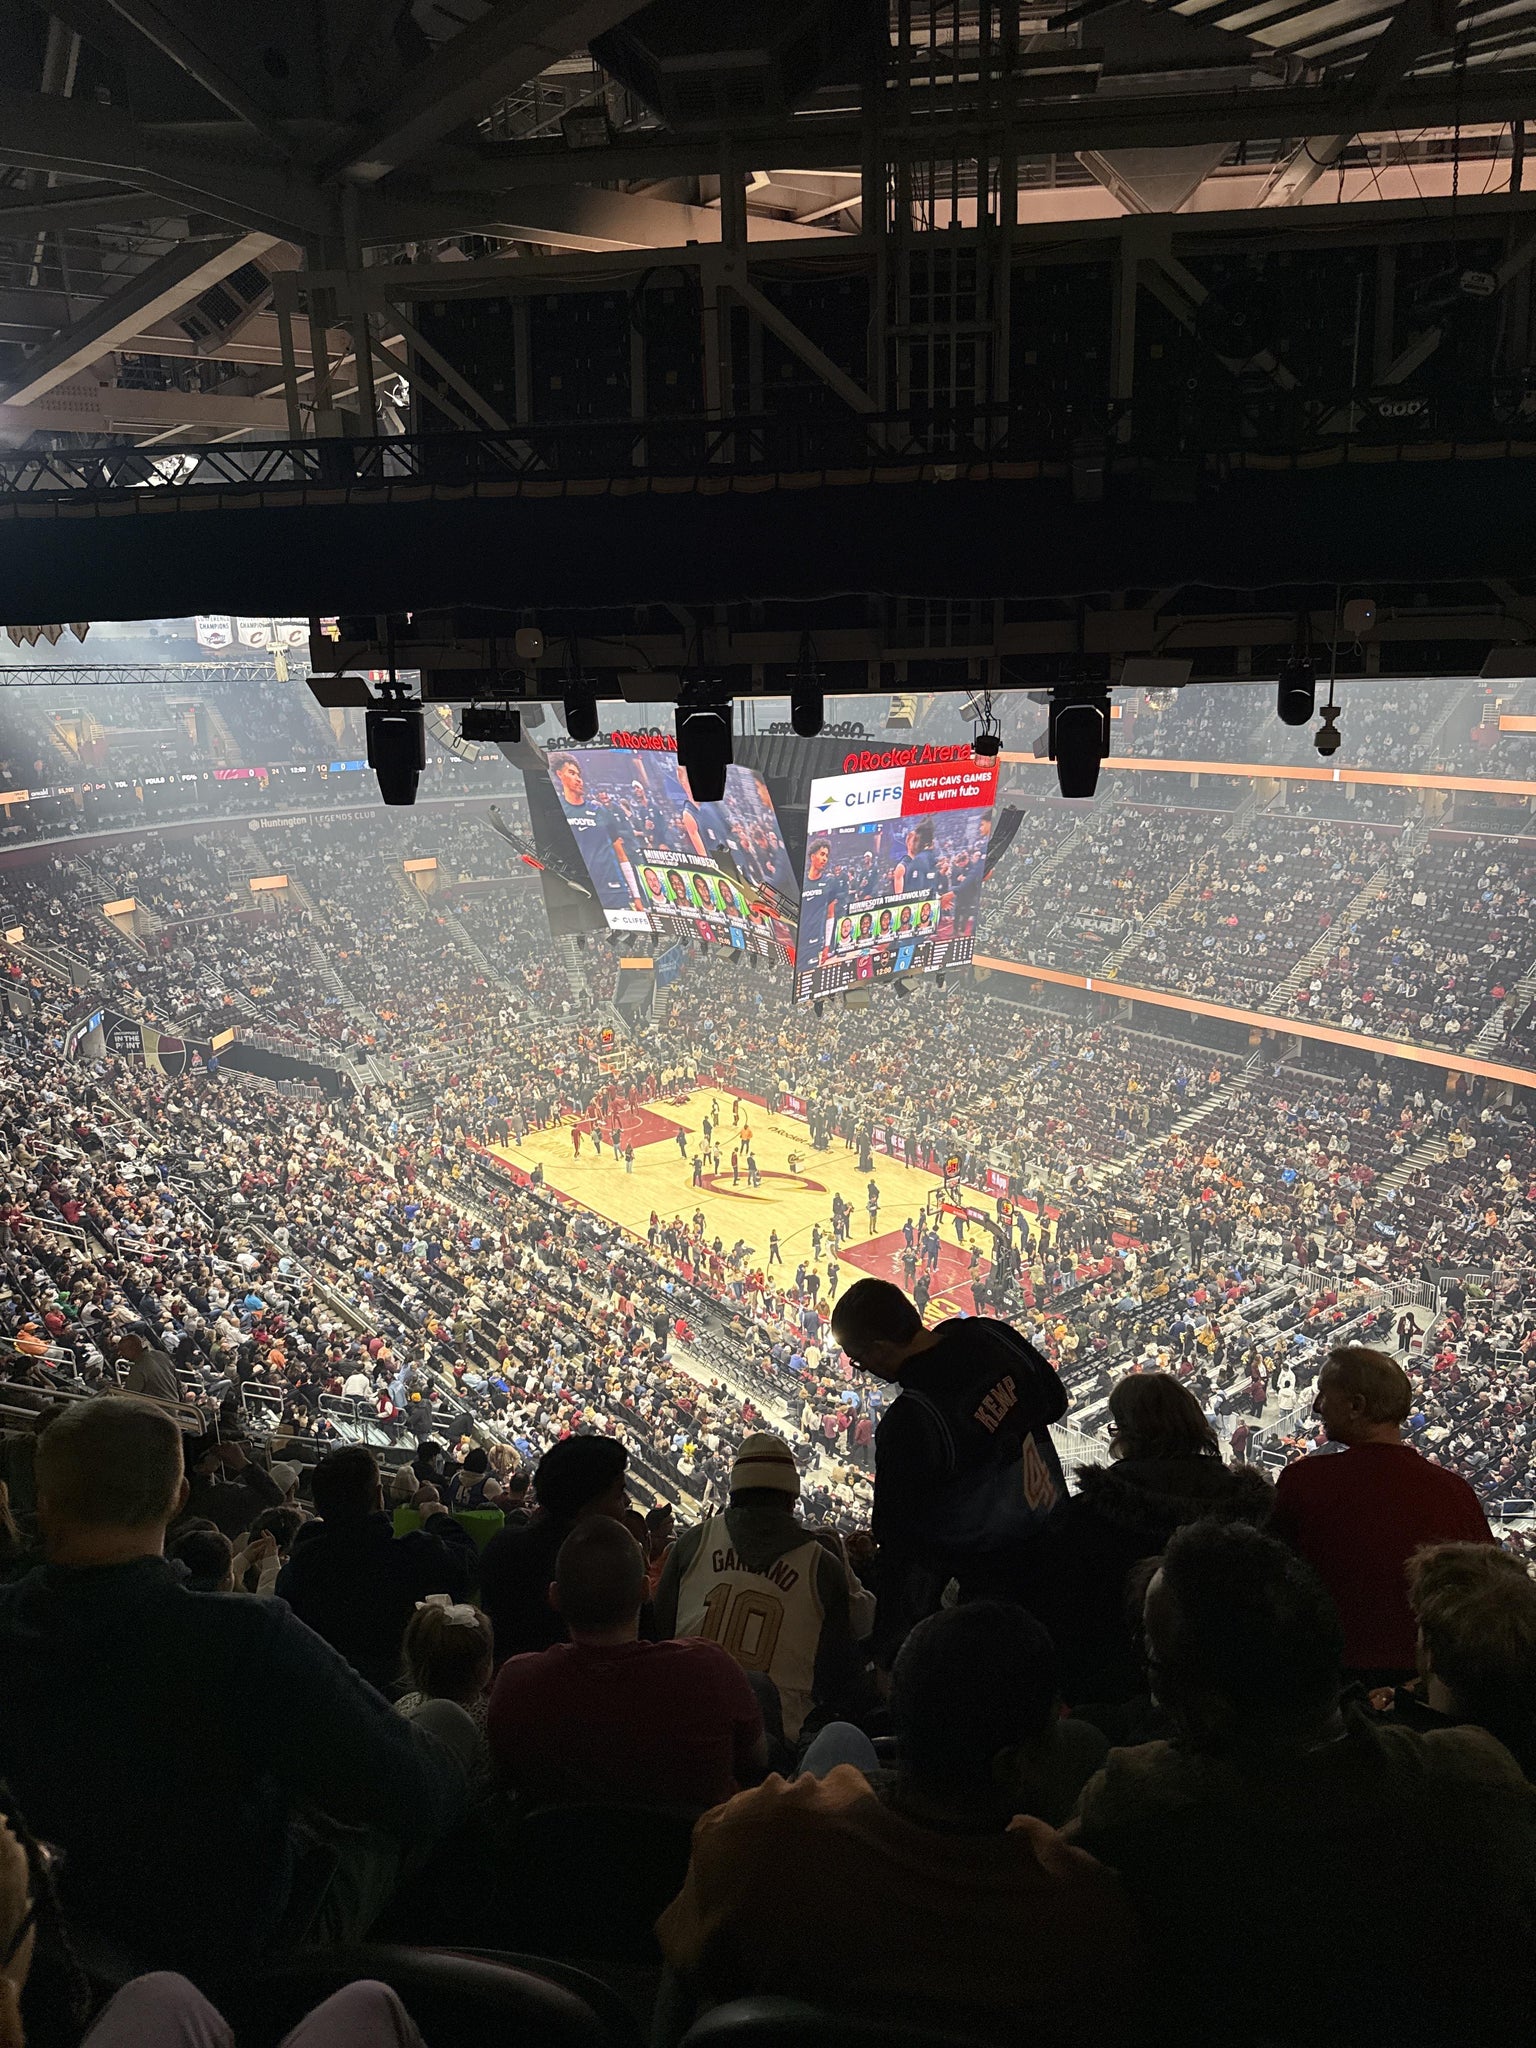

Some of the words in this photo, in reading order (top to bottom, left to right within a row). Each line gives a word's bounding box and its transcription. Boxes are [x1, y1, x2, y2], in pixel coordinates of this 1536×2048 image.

[620, 732, 667, 750] Rocket
[858, 746, 918, 771] Rocket
[920, 743, 972, 763] Arena
[909, 777, 938, 790] WATCH
[939, 775, 961, 786] CAVS
[963, 772, 992, 783] GAMES
[845, 786, 902, 807] CLIFFS
[918, 790, 936, 801] LIVE
[937, 789, 957, 799] WITH
[960, 785, 980, 796] fubo
[260, 816, 307, 829] Huntington
[315, 813, 353, 824] LEGENDS
[354, 811, 376, 820] CLUB
[643, 849, 689, 864] MINNESOTA
[849, 896, 884, 910] MINNESOTA
[884, 889, 931, 904] TIMBERWOLVES
[622, 916, 649, 926] CLIFFS
[861, 969, 868, 978] 0
[876, 966, 892, 976] 12:00
[900, 961, 906, 970] 0
[974, 1375, 1019, 1434] KEMP
[712, 1548, 799, 1593] GAND
[701, 1582, 785, 1673] 10
